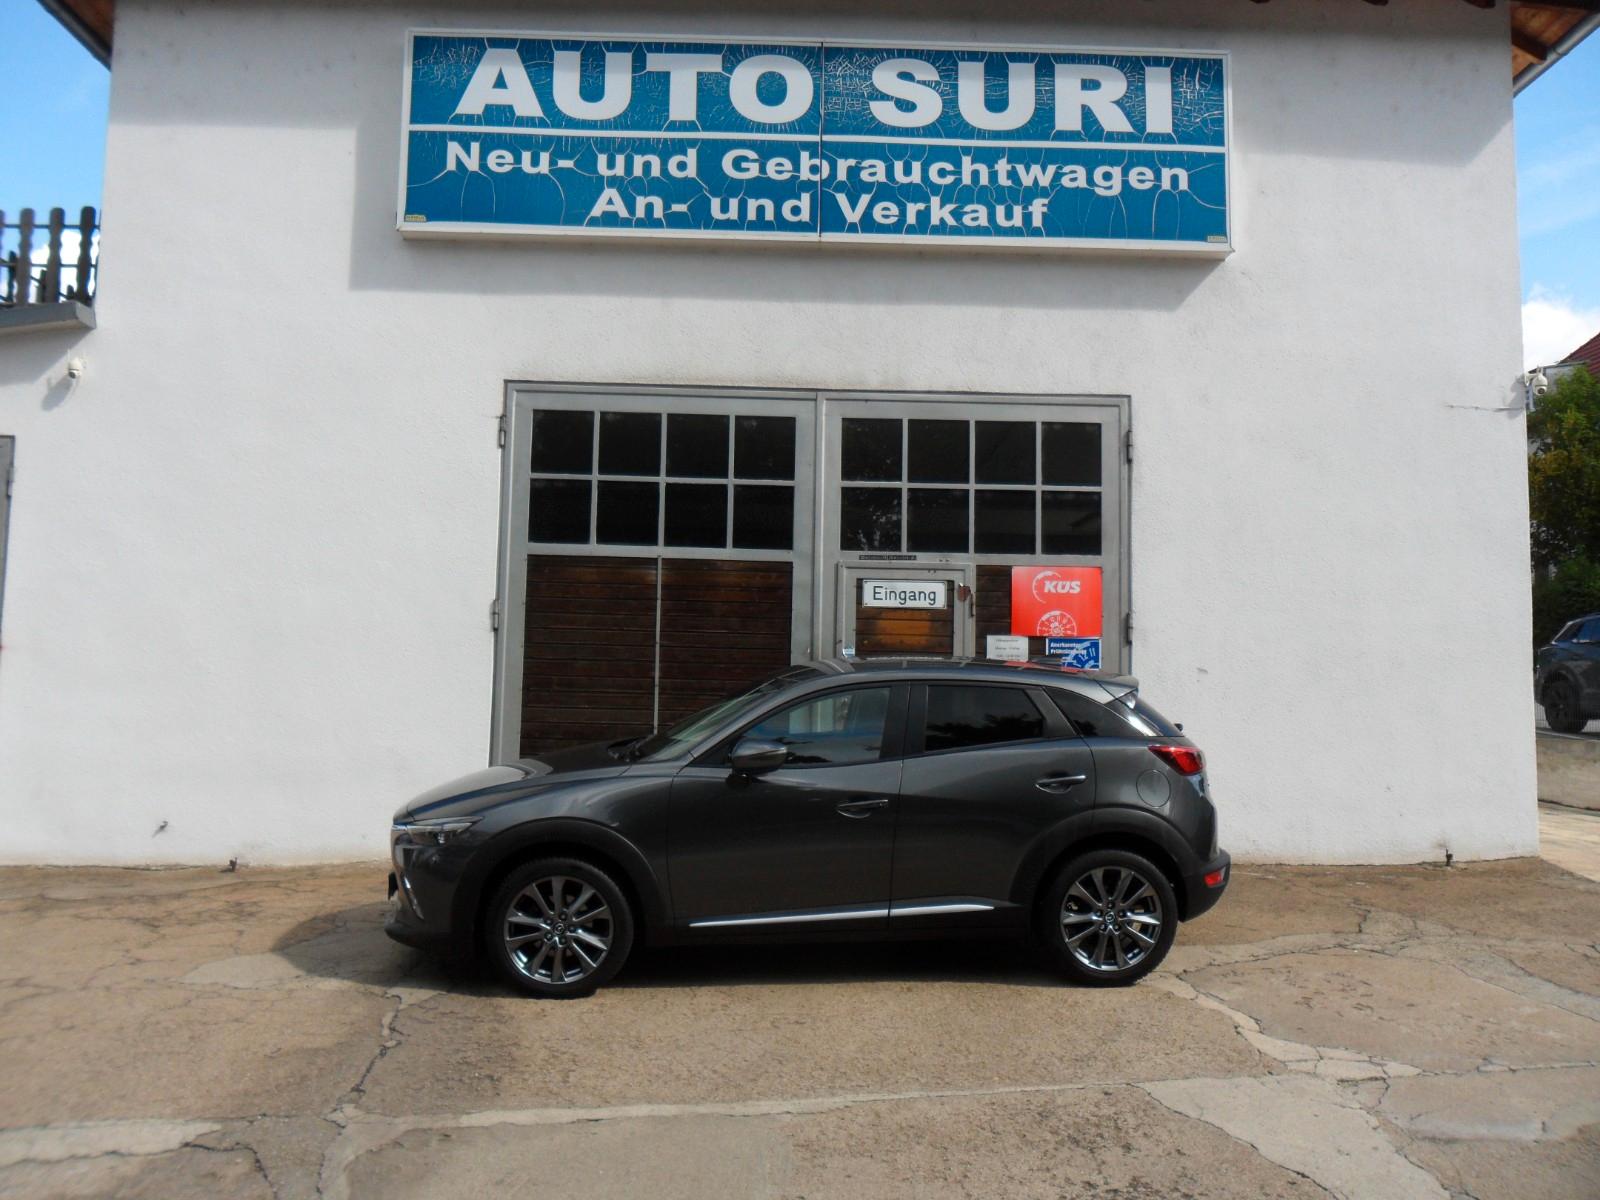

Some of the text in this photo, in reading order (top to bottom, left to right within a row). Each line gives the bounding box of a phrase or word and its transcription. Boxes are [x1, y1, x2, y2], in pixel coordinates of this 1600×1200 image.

[454, 46, 1174, 135] AUTO SURI
[446, 140, 1190, 197] Neu- und Gebrauchtwagen
[588, 187, 1049, 229] An- und Verkauf
[872, 585, 938, 607] Eingang
[1043, 580, 1082, 595] KÜS
